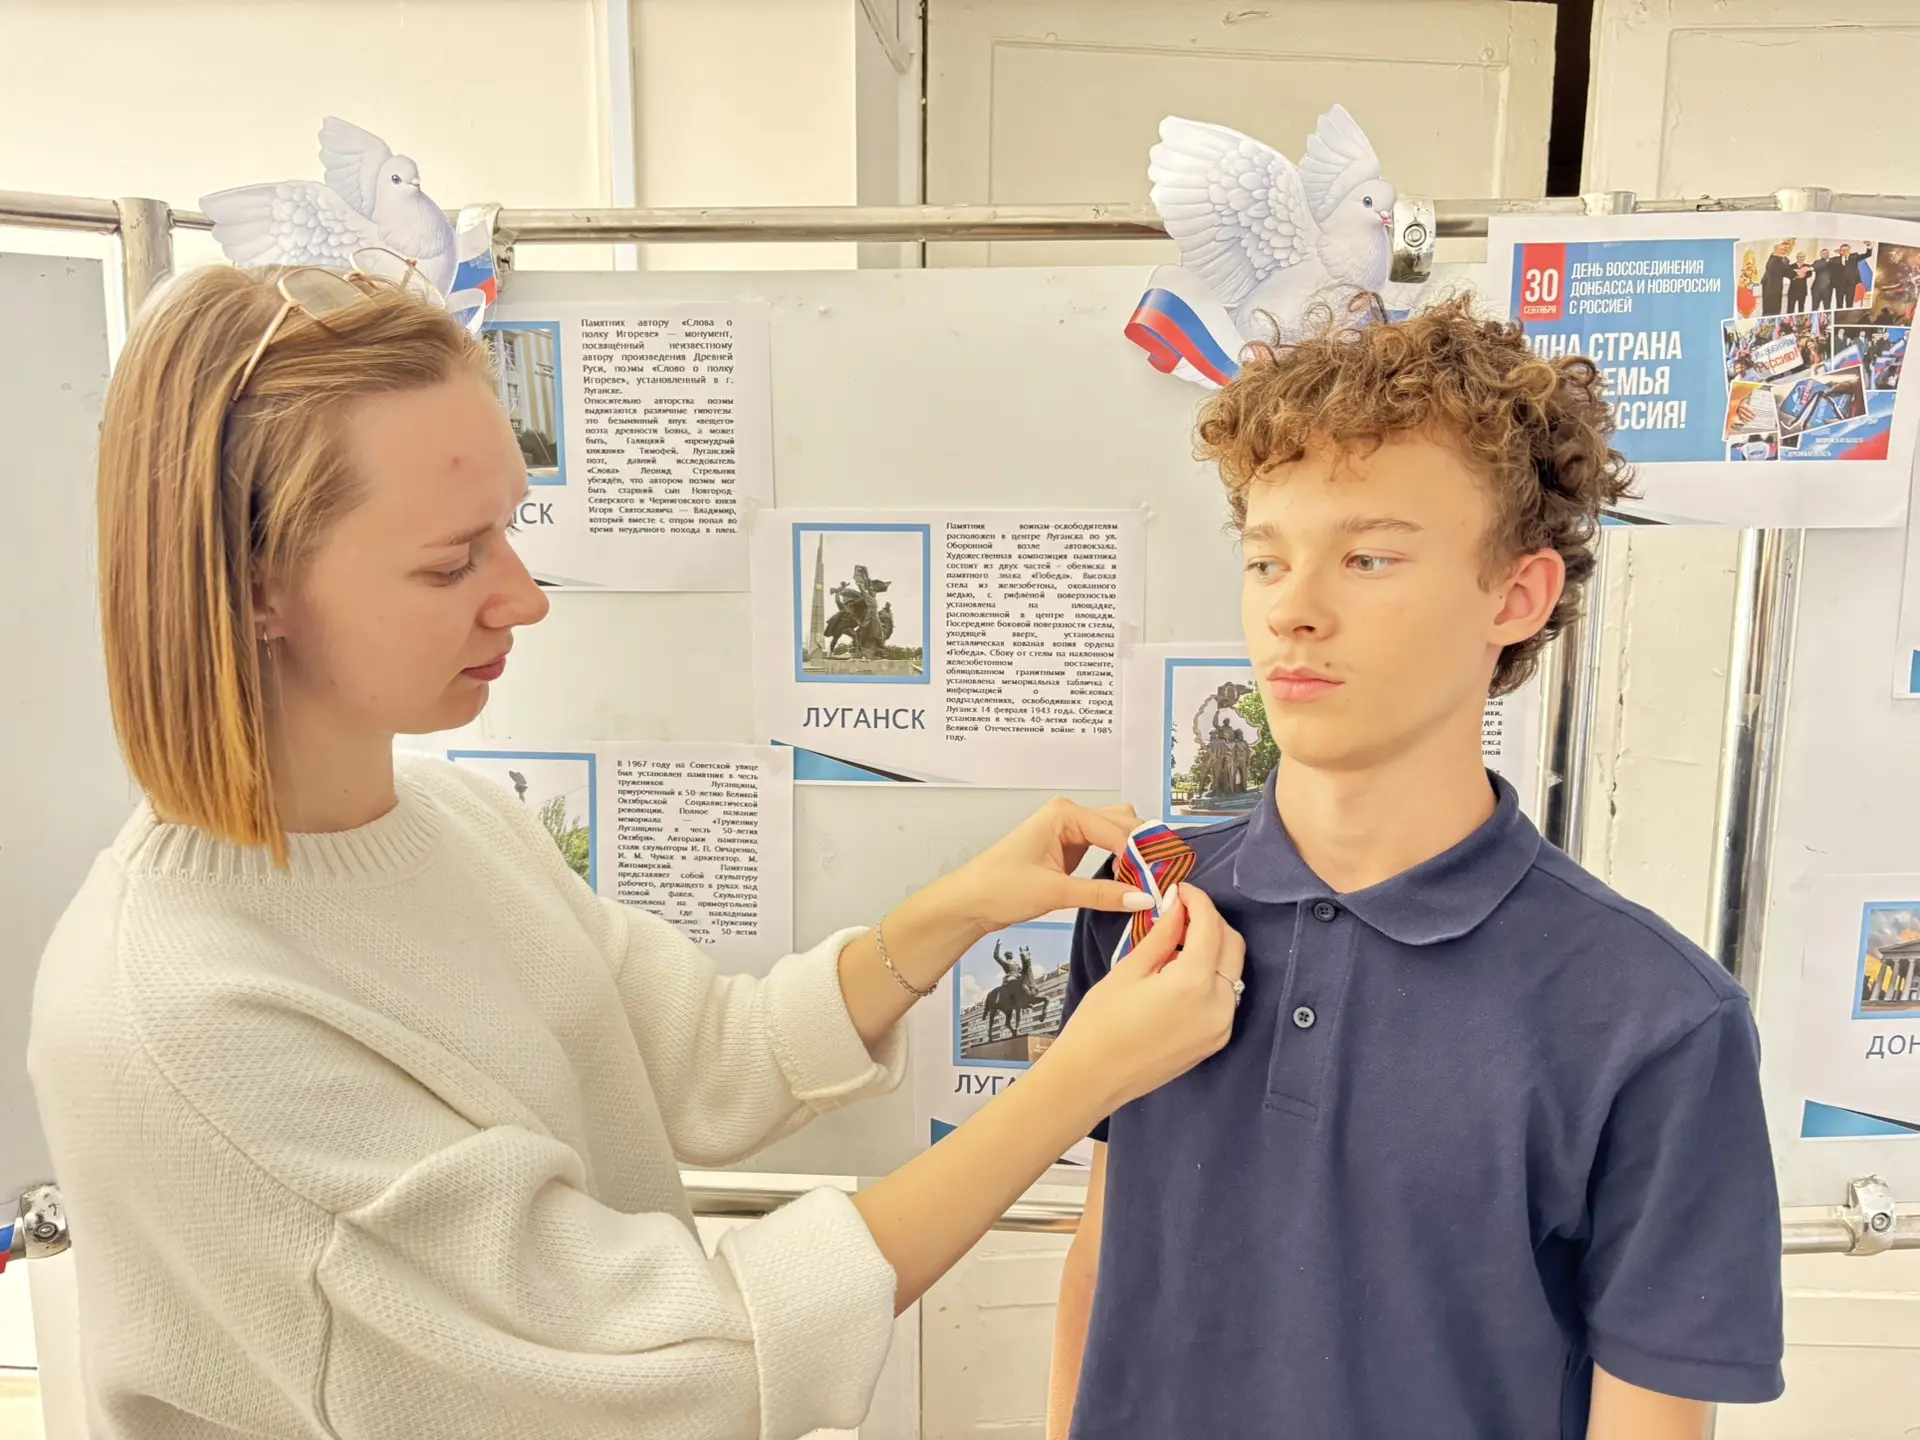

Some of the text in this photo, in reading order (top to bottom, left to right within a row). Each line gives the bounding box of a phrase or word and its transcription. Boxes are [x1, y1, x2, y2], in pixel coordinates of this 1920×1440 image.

[1571, 260, 1704, 279] ДЕНЬ ВОССОЕДИНЕНИЯ
[1525, 268, 1559, 303] 30
[1570, 278, 1721, 298] ДОНБАССА И НОВОРОССИИ
[1524, 305, 1557, 315] СЕНТЯБРЯ
[1569, 296, 1632, 315] С РОССИЕЙ
[581, 319, 625, 327] Памятник
[637, 320, 669, 328] автору
[682, 319, 714, 327] «Слова
[582, 331, 608, 339] полку
[582, 341, 732, 350] посвящённый неизвестному
[1589, 331, 1682, 362] СТРАНА
[582, 352, 732, 362] автору произведения Древней
[652, 364, 685, 372] «Слово
[707, 365, 733, 373] полку
[636, 375, 706, 385] установленный
[1598, 366, 1671, 396] ЕМЬЯ
[803, 707, 925, 729] ЛУГАНСК
